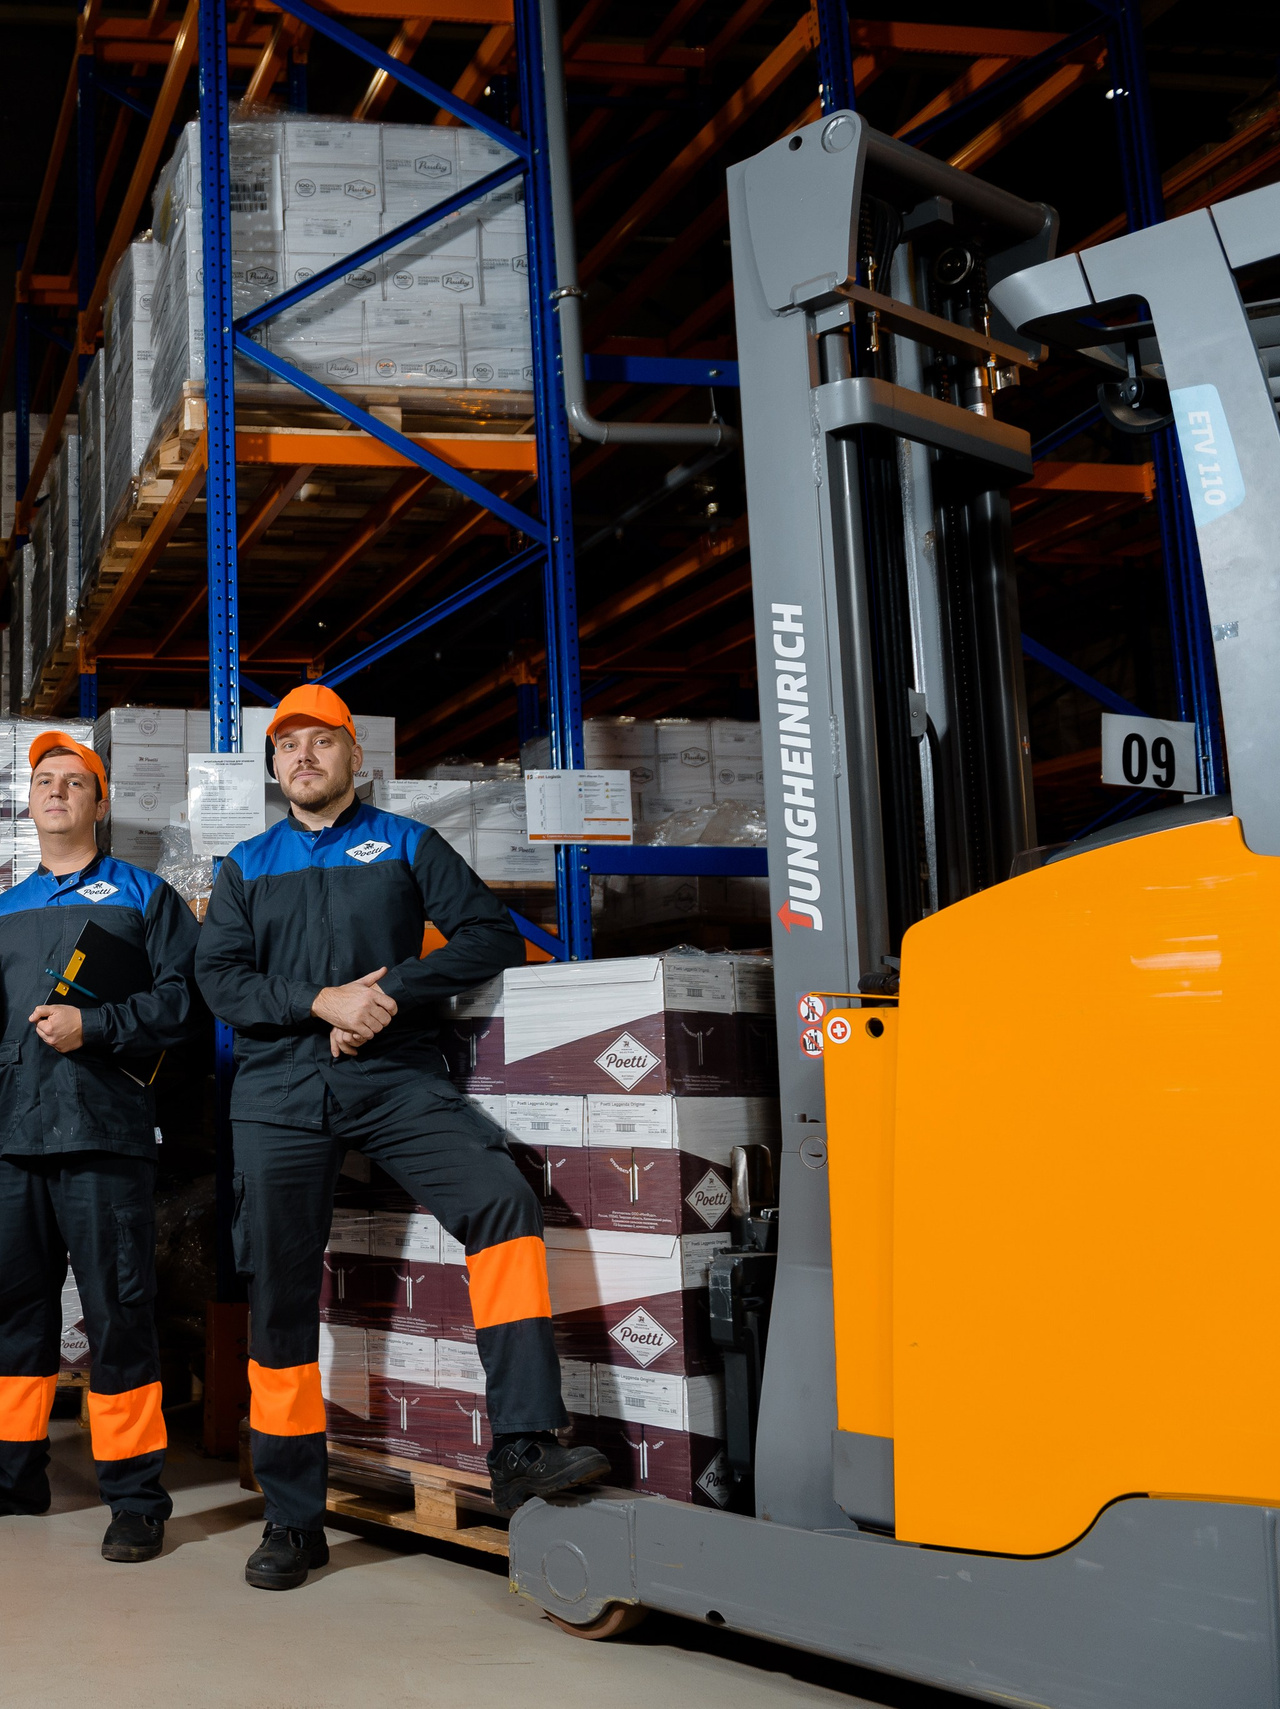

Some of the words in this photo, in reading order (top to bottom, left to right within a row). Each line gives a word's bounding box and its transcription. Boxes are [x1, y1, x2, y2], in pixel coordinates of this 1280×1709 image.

[418, 162, 448, 172] Paulig
[347, 184, 372, 194] Paulig
[249, 270, 274, 283] Paulig
[445, 277, 470, 287] Paulig
[428, 365, 453, 375] Paulig
[1188, 411, 1218, 455] ETV
[1198, 462, 1227, 506] 110
[771, 602, 824, 932] JUNGHEINRICH
[1122, 733, 1175, 788] 09
[353, 846, 383, 857] Poetti
[83, 888, 111, 896] Poetti
[606, 1053, 648, 1068] Poetti
[695, 1190, 728, 1206] Poetti
[620, 1327, 663, 1346] Poetti
